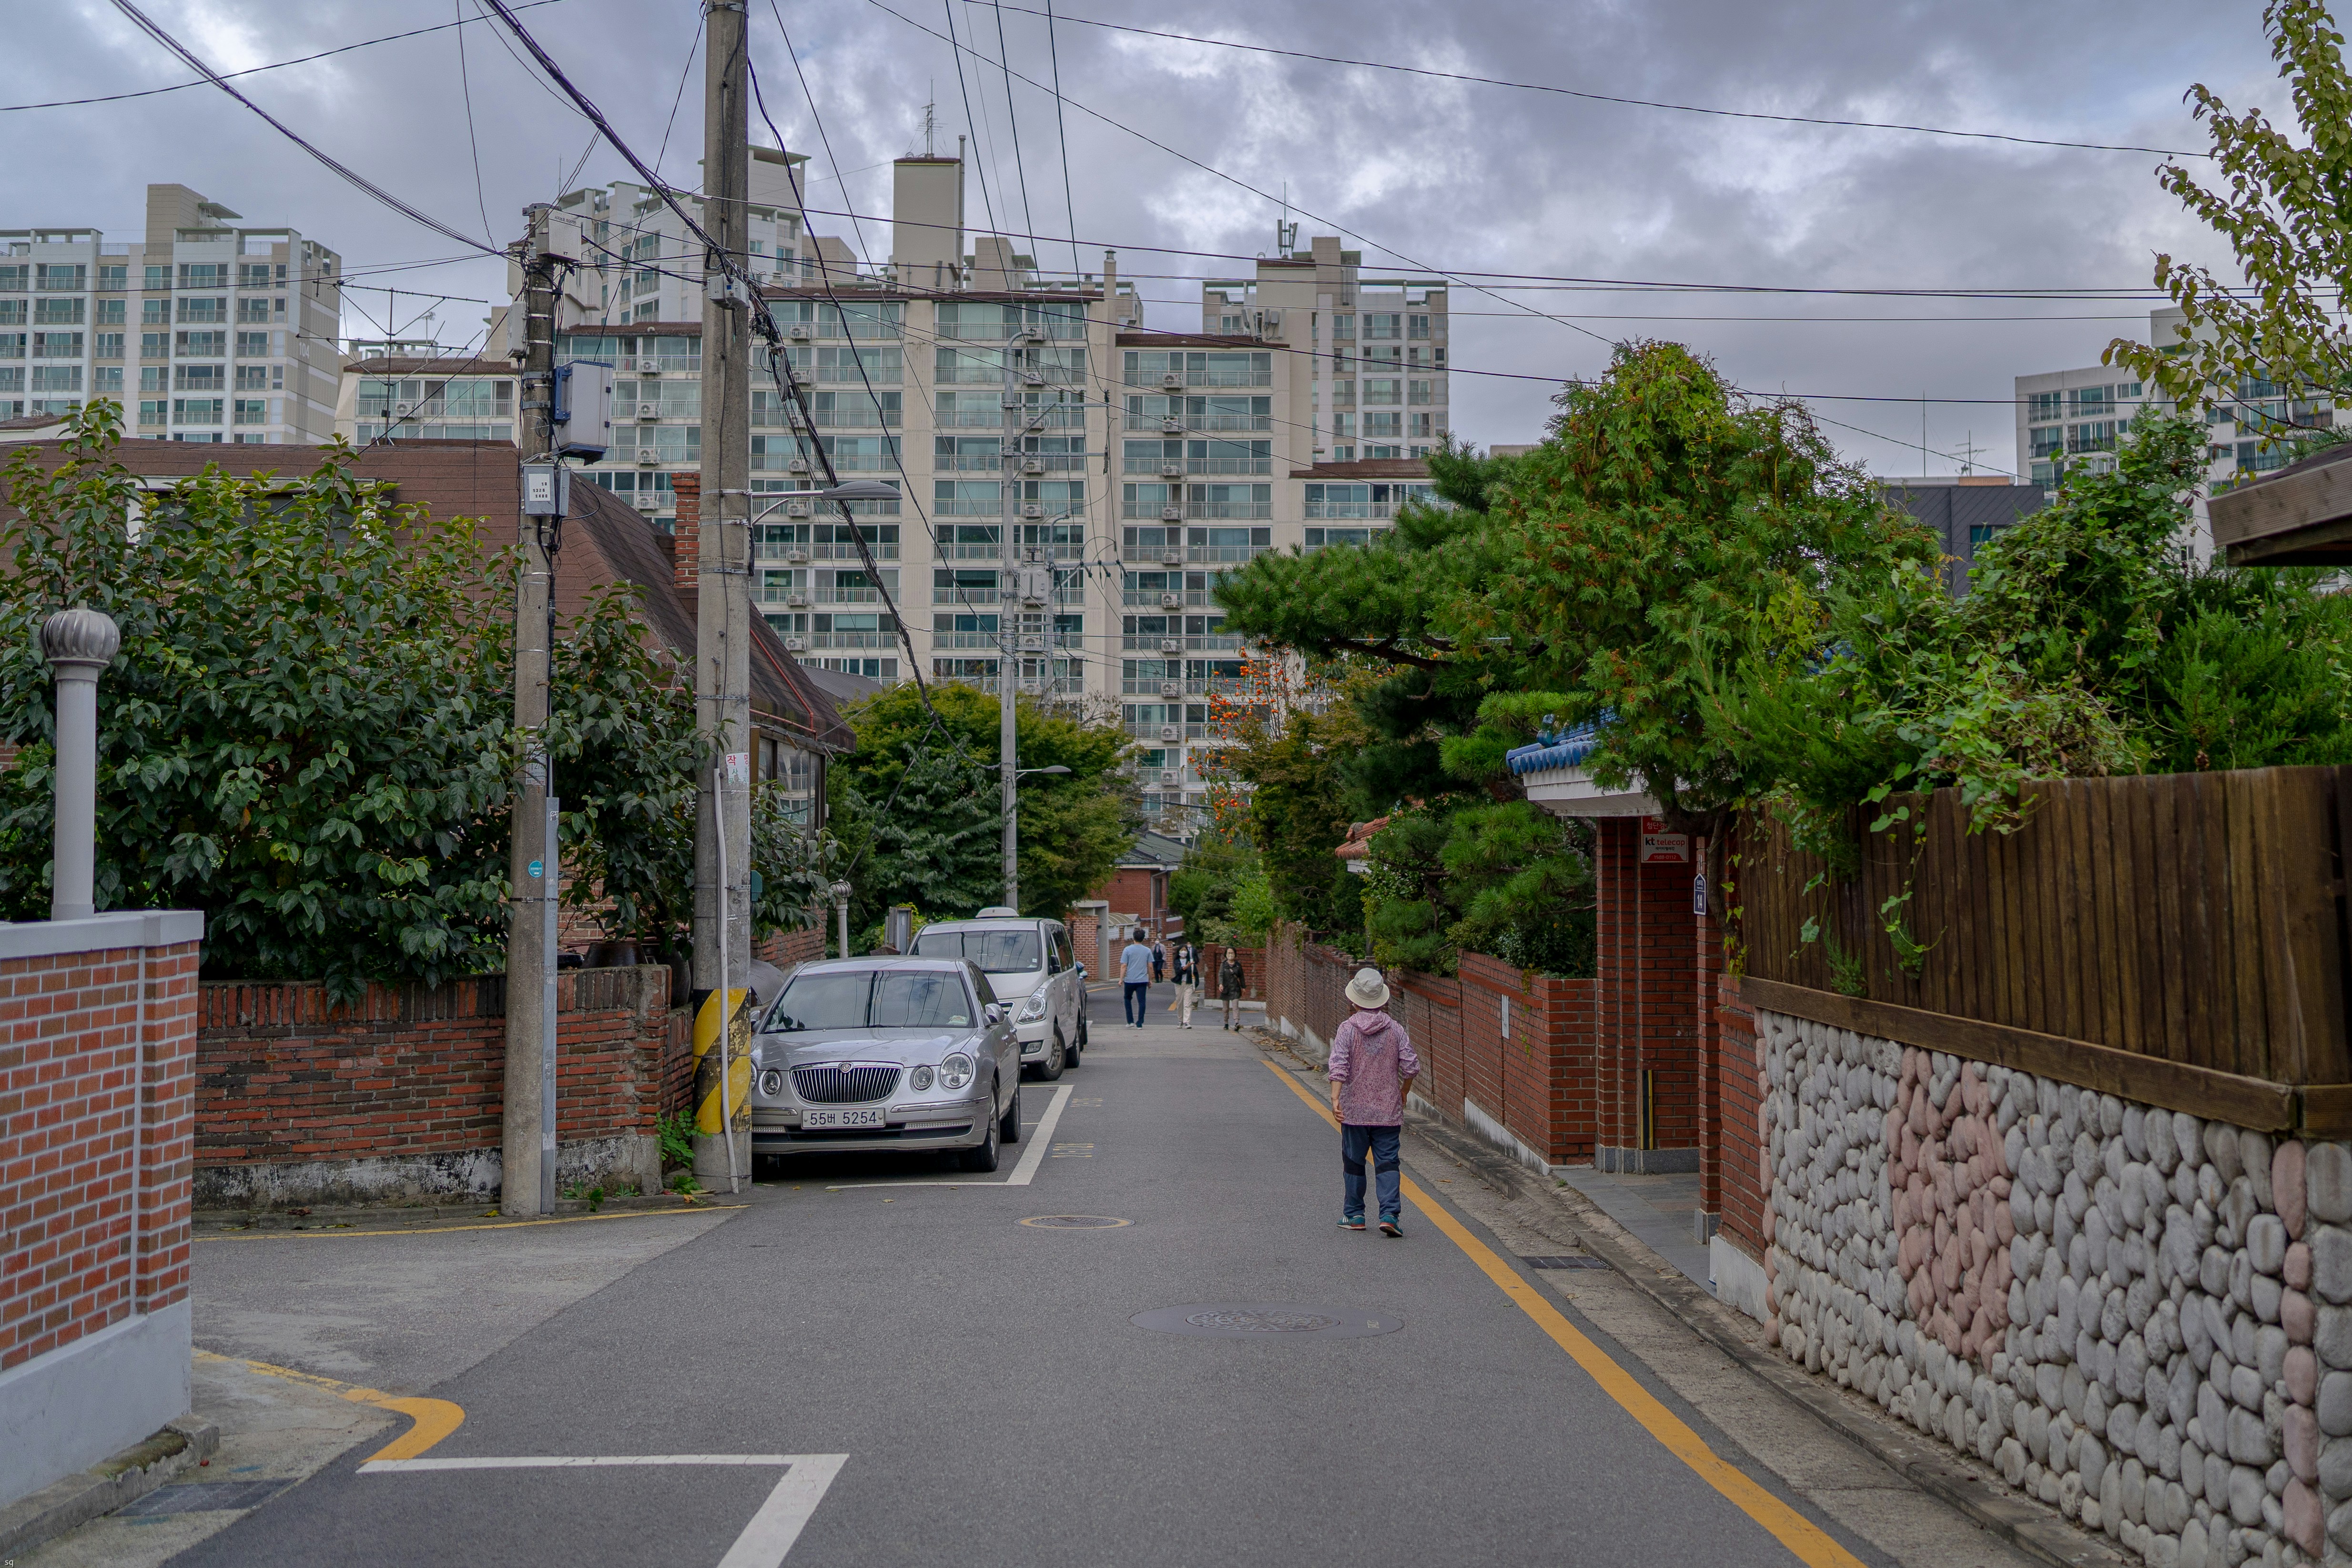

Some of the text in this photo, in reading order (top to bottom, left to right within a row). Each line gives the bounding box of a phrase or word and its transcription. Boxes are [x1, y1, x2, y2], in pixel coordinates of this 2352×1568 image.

[299, 342, 310, 359] 104
[1647, 821, 1667, 830] 첨단경
[1645, 837, 1685, 847] kt telecop
[1697, 894, 1703, 909] 14
[810, 1111, 877, 1125] 55버 5254
